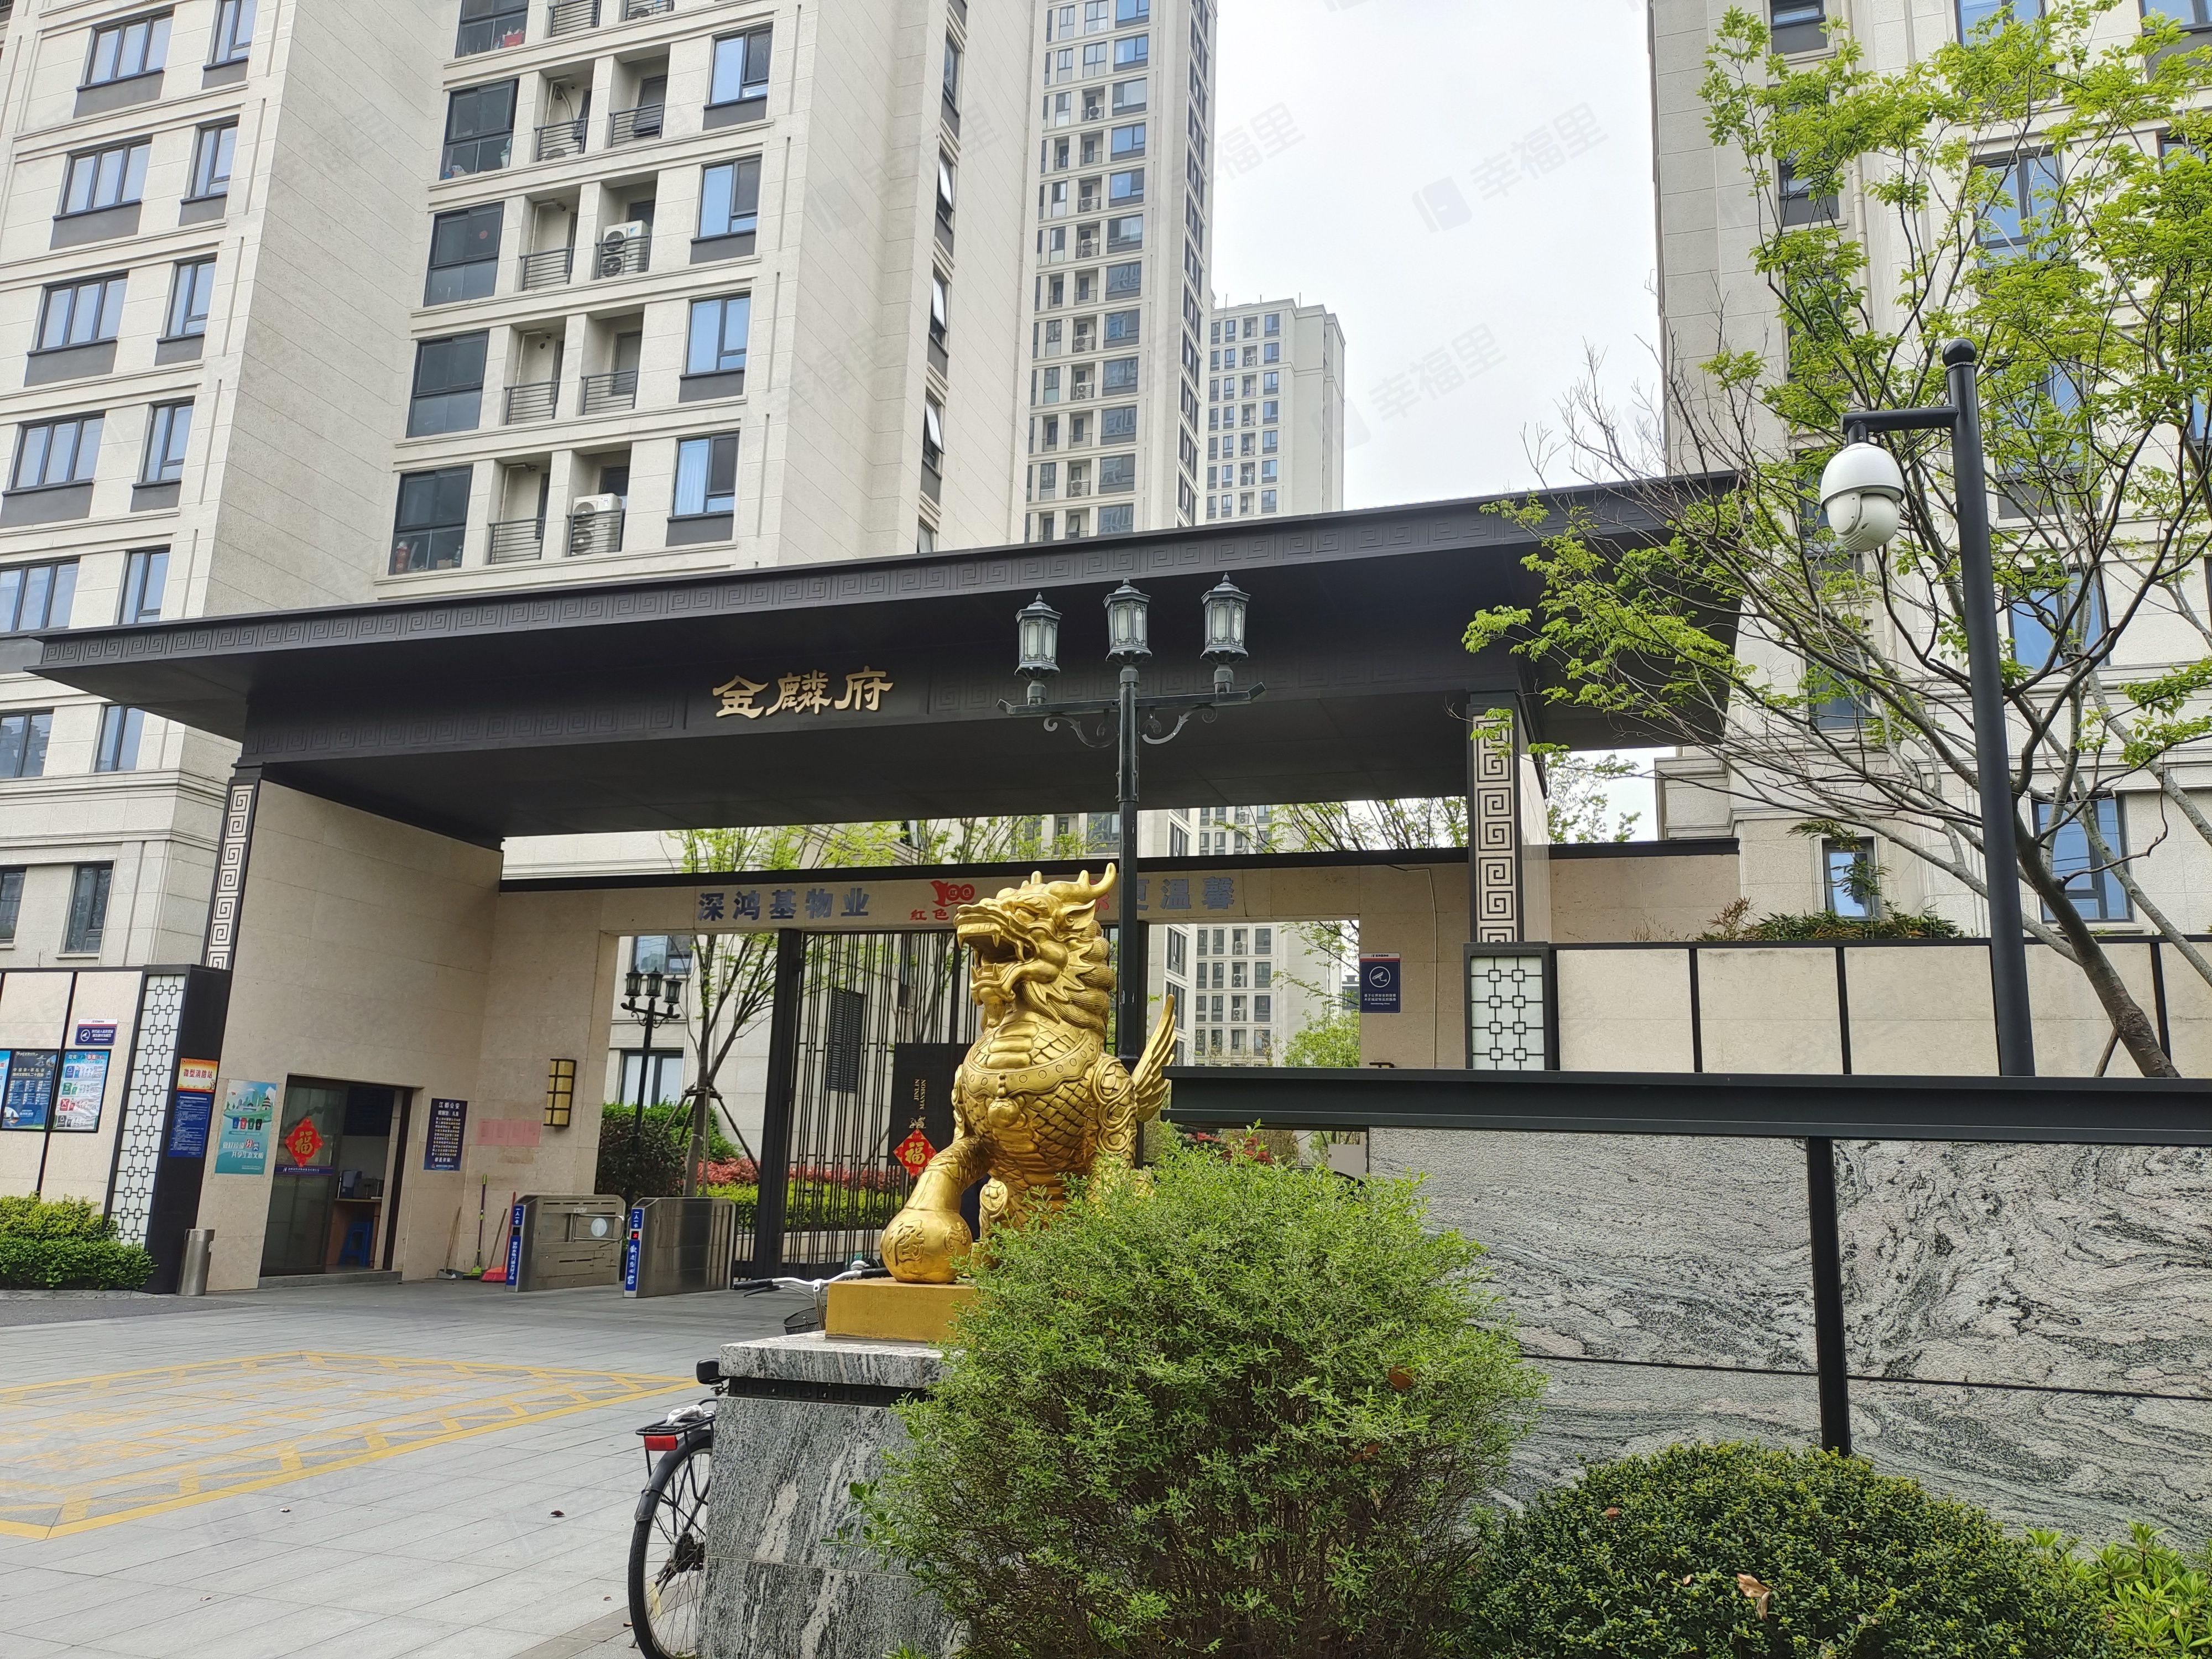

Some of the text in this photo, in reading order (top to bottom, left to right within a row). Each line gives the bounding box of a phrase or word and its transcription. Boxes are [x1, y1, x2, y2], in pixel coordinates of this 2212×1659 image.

[713, 665, 894, 719] 金麟府
[698, 888, 870, 921] 深鸿基物业
[910, 909, 950, 921] 红色
[184, 1068, 213, 1078] 微型消防站
[295, 1131, 313, 1155] 福
[905, 1141, 926, 1164] 福
